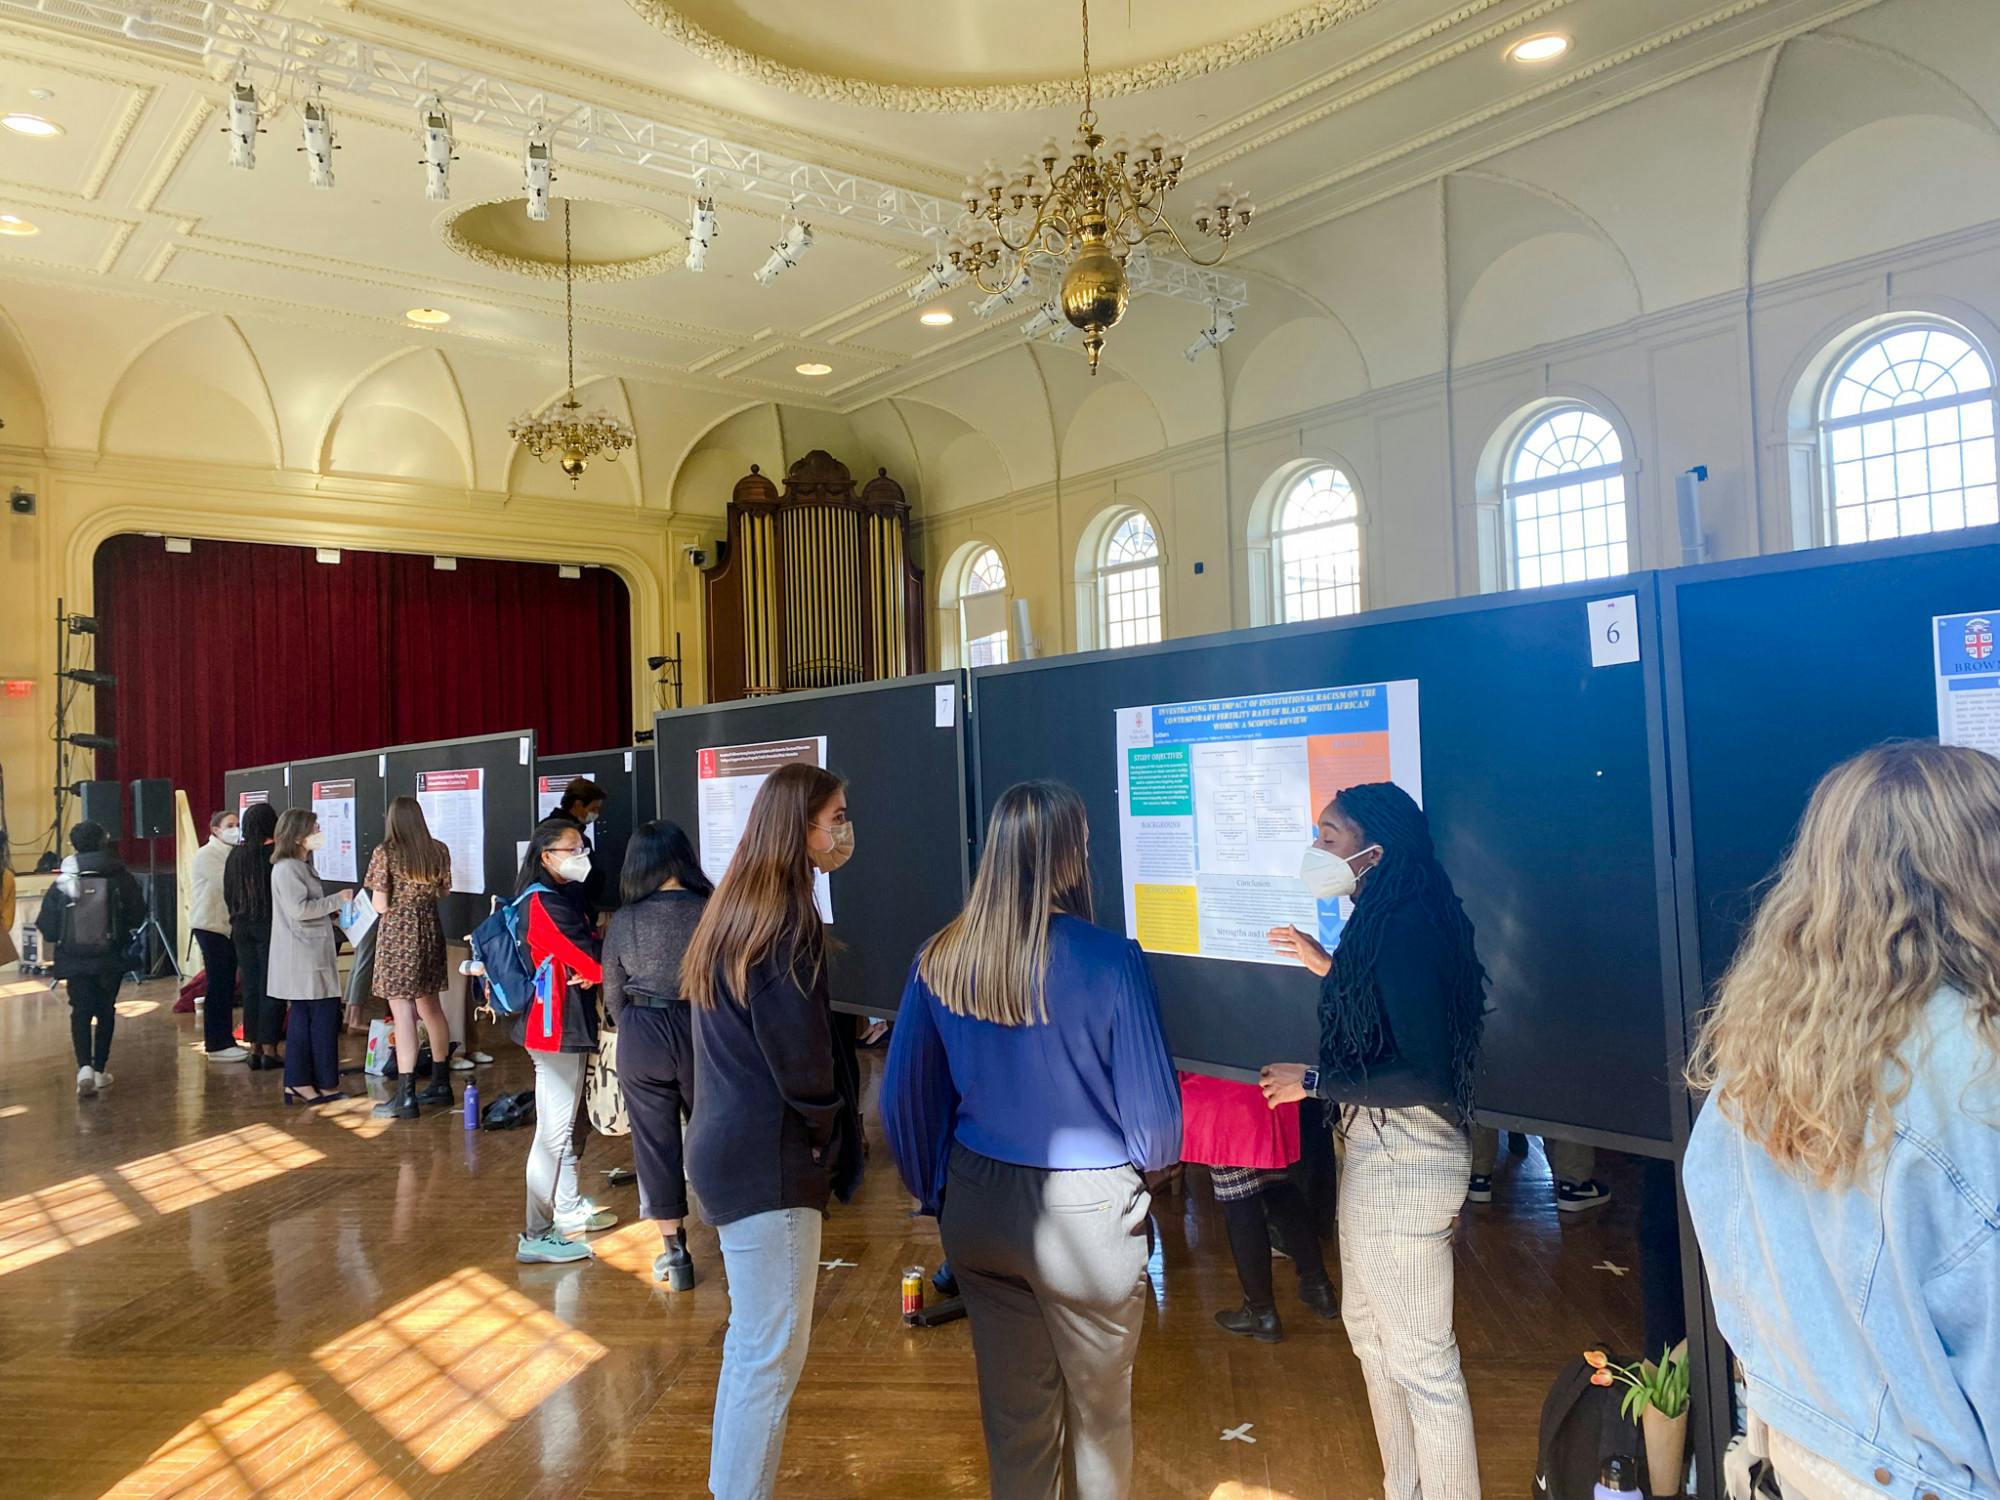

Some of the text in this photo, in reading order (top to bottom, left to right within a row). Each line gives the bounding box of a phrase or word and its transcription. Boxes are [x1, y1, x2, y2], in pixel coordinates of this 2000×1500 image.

[1607, 620, 1620, 644] 6
[1955, 661, 2000, 673] BROW
[1159, 687, 1376, 715] INVESTIGATING THE IMPACT OF INSTITUTIONAL RACISM ON THE
[1164, 699, 1370, 725] CONTEMPORARY FERTILITY RATE OF BLACK SOUTH AFRICAN
[1247, 718, 1278, 728] SCOPING
[1279, 715, 1308, 725] REVIEW
[1151, 751, 1183, 761] OBJECTIVES
[1216, 927, 1246, 938] Strengths
[1248, 929, 1261, 938] and
